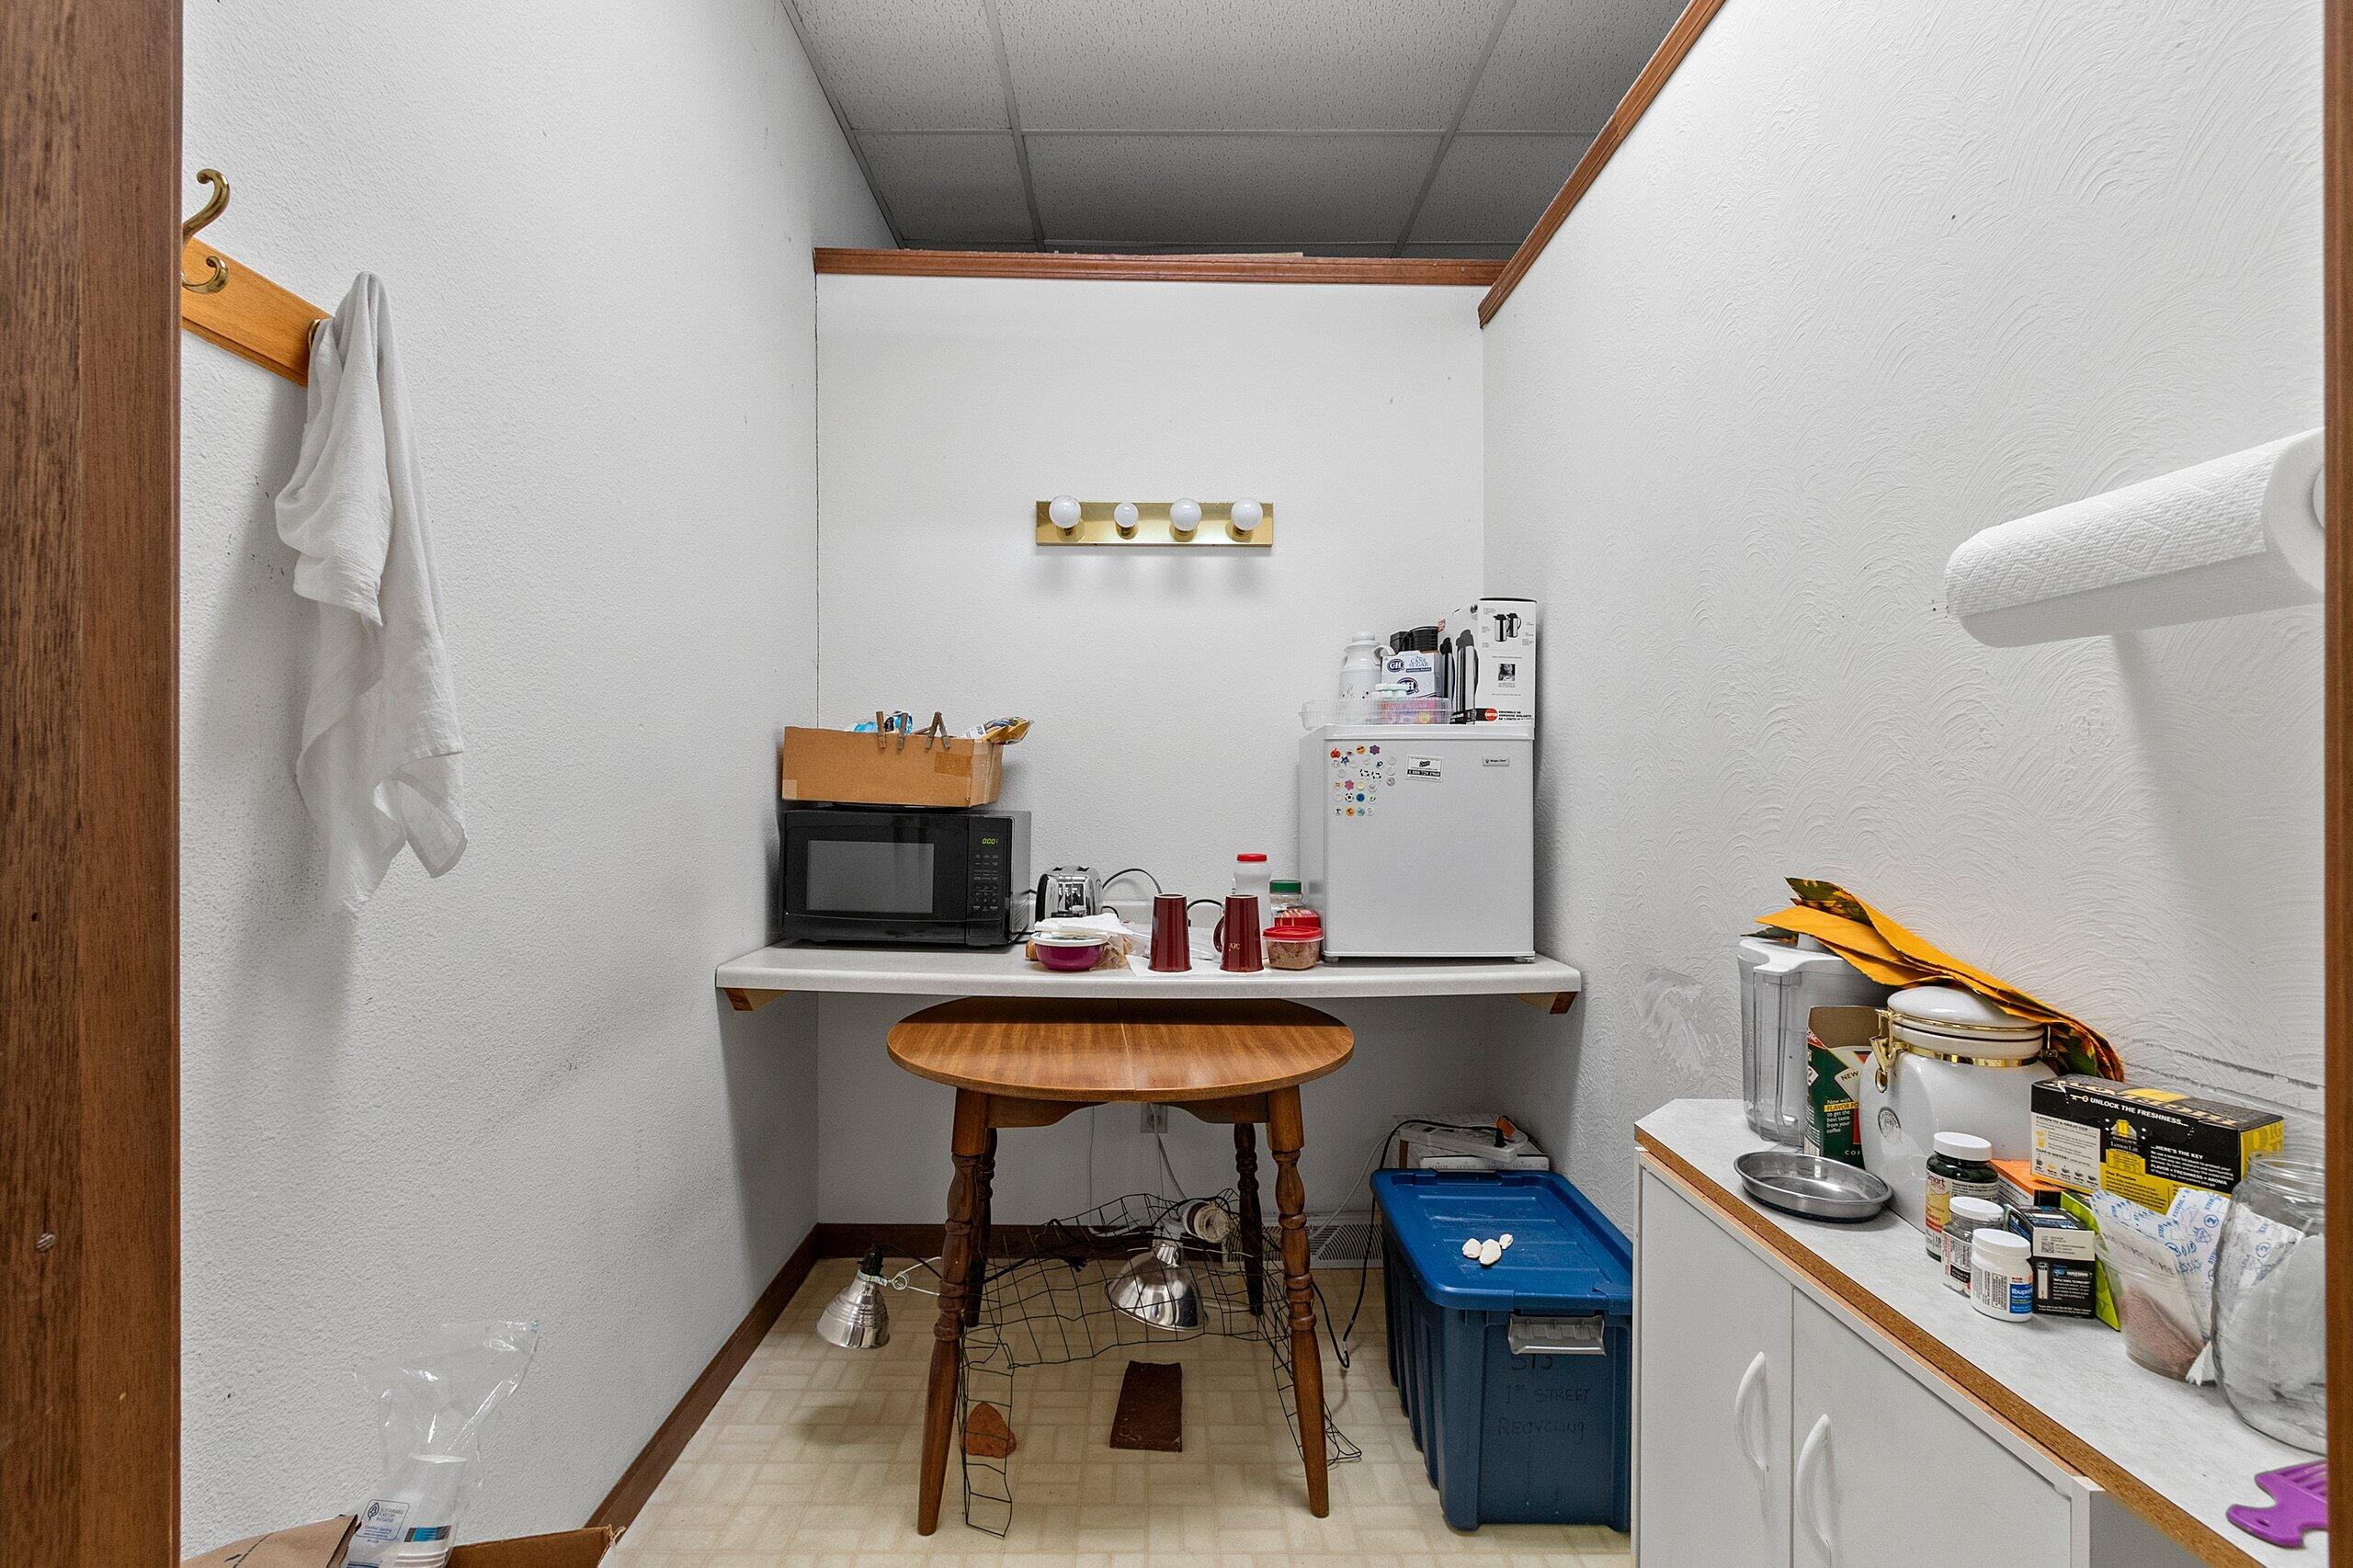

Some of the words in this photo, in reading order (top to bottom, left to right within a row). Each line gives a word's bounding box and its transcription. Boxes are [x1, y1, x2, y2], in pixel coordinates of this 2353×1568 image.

[1840, 1071, 1859, 1082] NEW
[1826, 1103, 1849, 1111] FLAVOR
[2090, 1097, 2120, 1110] UNLOCK
[2120, 1105, 2136, 1114] THE
[2177, 1149, 2190, 1157] THE
[2190, 1152, 2204, 1160] KEY
[1534, 1388, 1591, 1403] STREET
